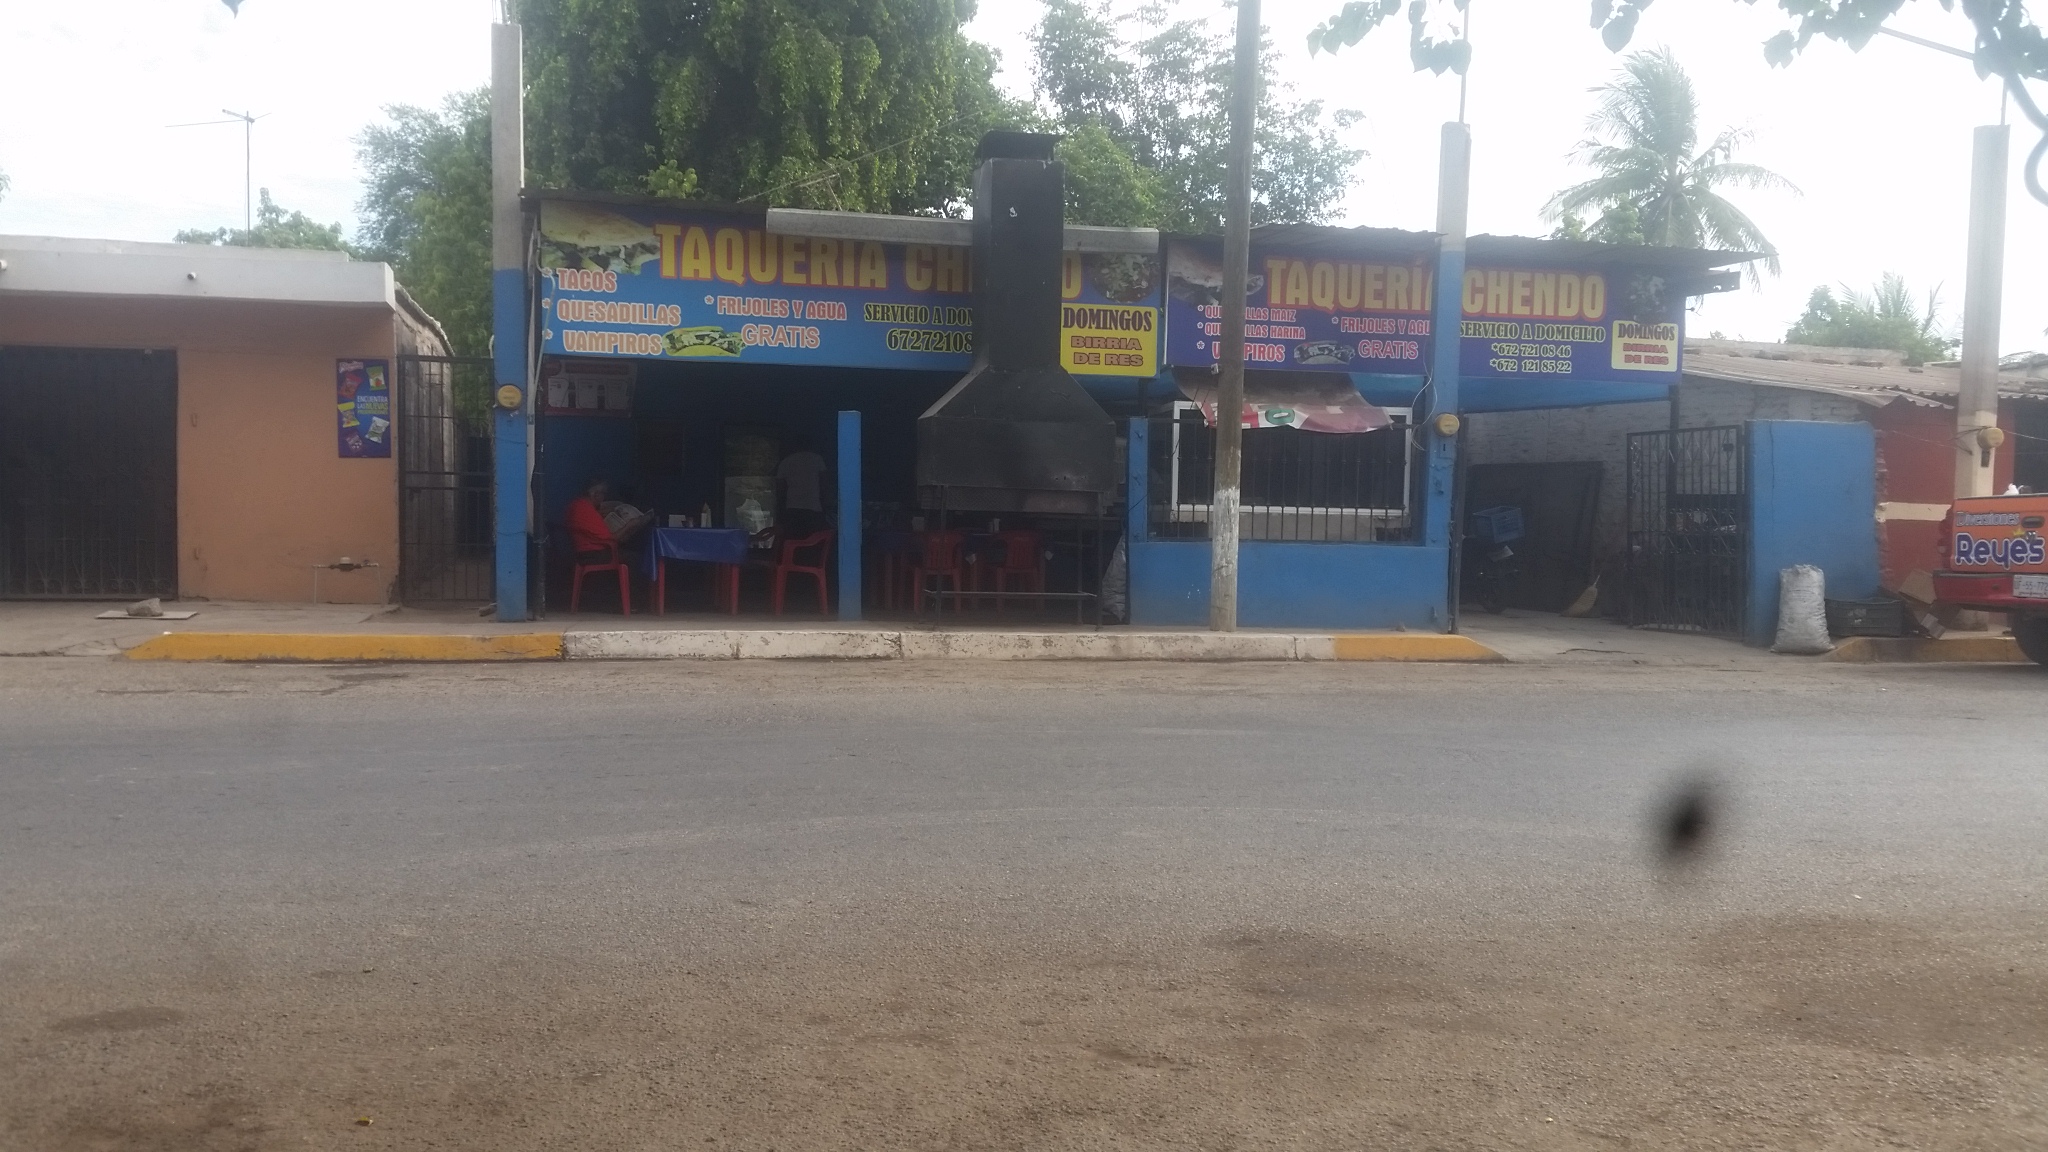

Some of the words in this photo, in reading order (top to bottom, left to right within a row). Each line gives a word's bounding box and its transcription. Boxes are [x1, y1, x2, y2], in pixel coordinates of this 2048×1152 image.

[556, 268, 616, 292] TACOS
[1462, 269, 1607, 320] CHENDO
[557, 299, 681, 326] QUESADILLAS
[717, 296, 789, 318] FRIJOLES
[793, 301, 802, 318] Y
[805, 301, 847, 320] AGUA
[864, 303, 928, 324] SERVICIO
[932, 306, 942, 325] A
[1270, 307, 1297, 322] MAIZ
[1063, 306, 1152, 332] DOMINGOS
[1340, 317, 1395, 334] FRIJOLES
[1398, 319, 1406, 335] Y
[562, 329, 662, 355] VAMPIROS
[741, 323, 821, 348] GRATIS
[1270, 325, 1305, 339] HARINA
[1460, 321, 1518, 339] SERVICIO
[1522, 324, 1533, 340] A
[1535, 325, 1606, 343] DOMICILIO
[1618, 323, 1675, 341] DOMINGOS
[1070, 336, 1142, 351] BIRRIA
[1358, 340, 1418, 360] GRATIS
[1520, 344, 1539, 357] 721
[1540, 345, 1555, 357] 08
[1557, 345, 1571, 358] 46
[1074, 353, 1100, 365] DE
[1105, 353, 1143, 367] RES
[1522, 360, 1541, 373] 121
[1541, 360, 1555, 373] 85
[1557, 361, 1571, 374] 22
[1625, 355, 1641, 363] DE
[1955, 532, 2046, 570] Reyes
